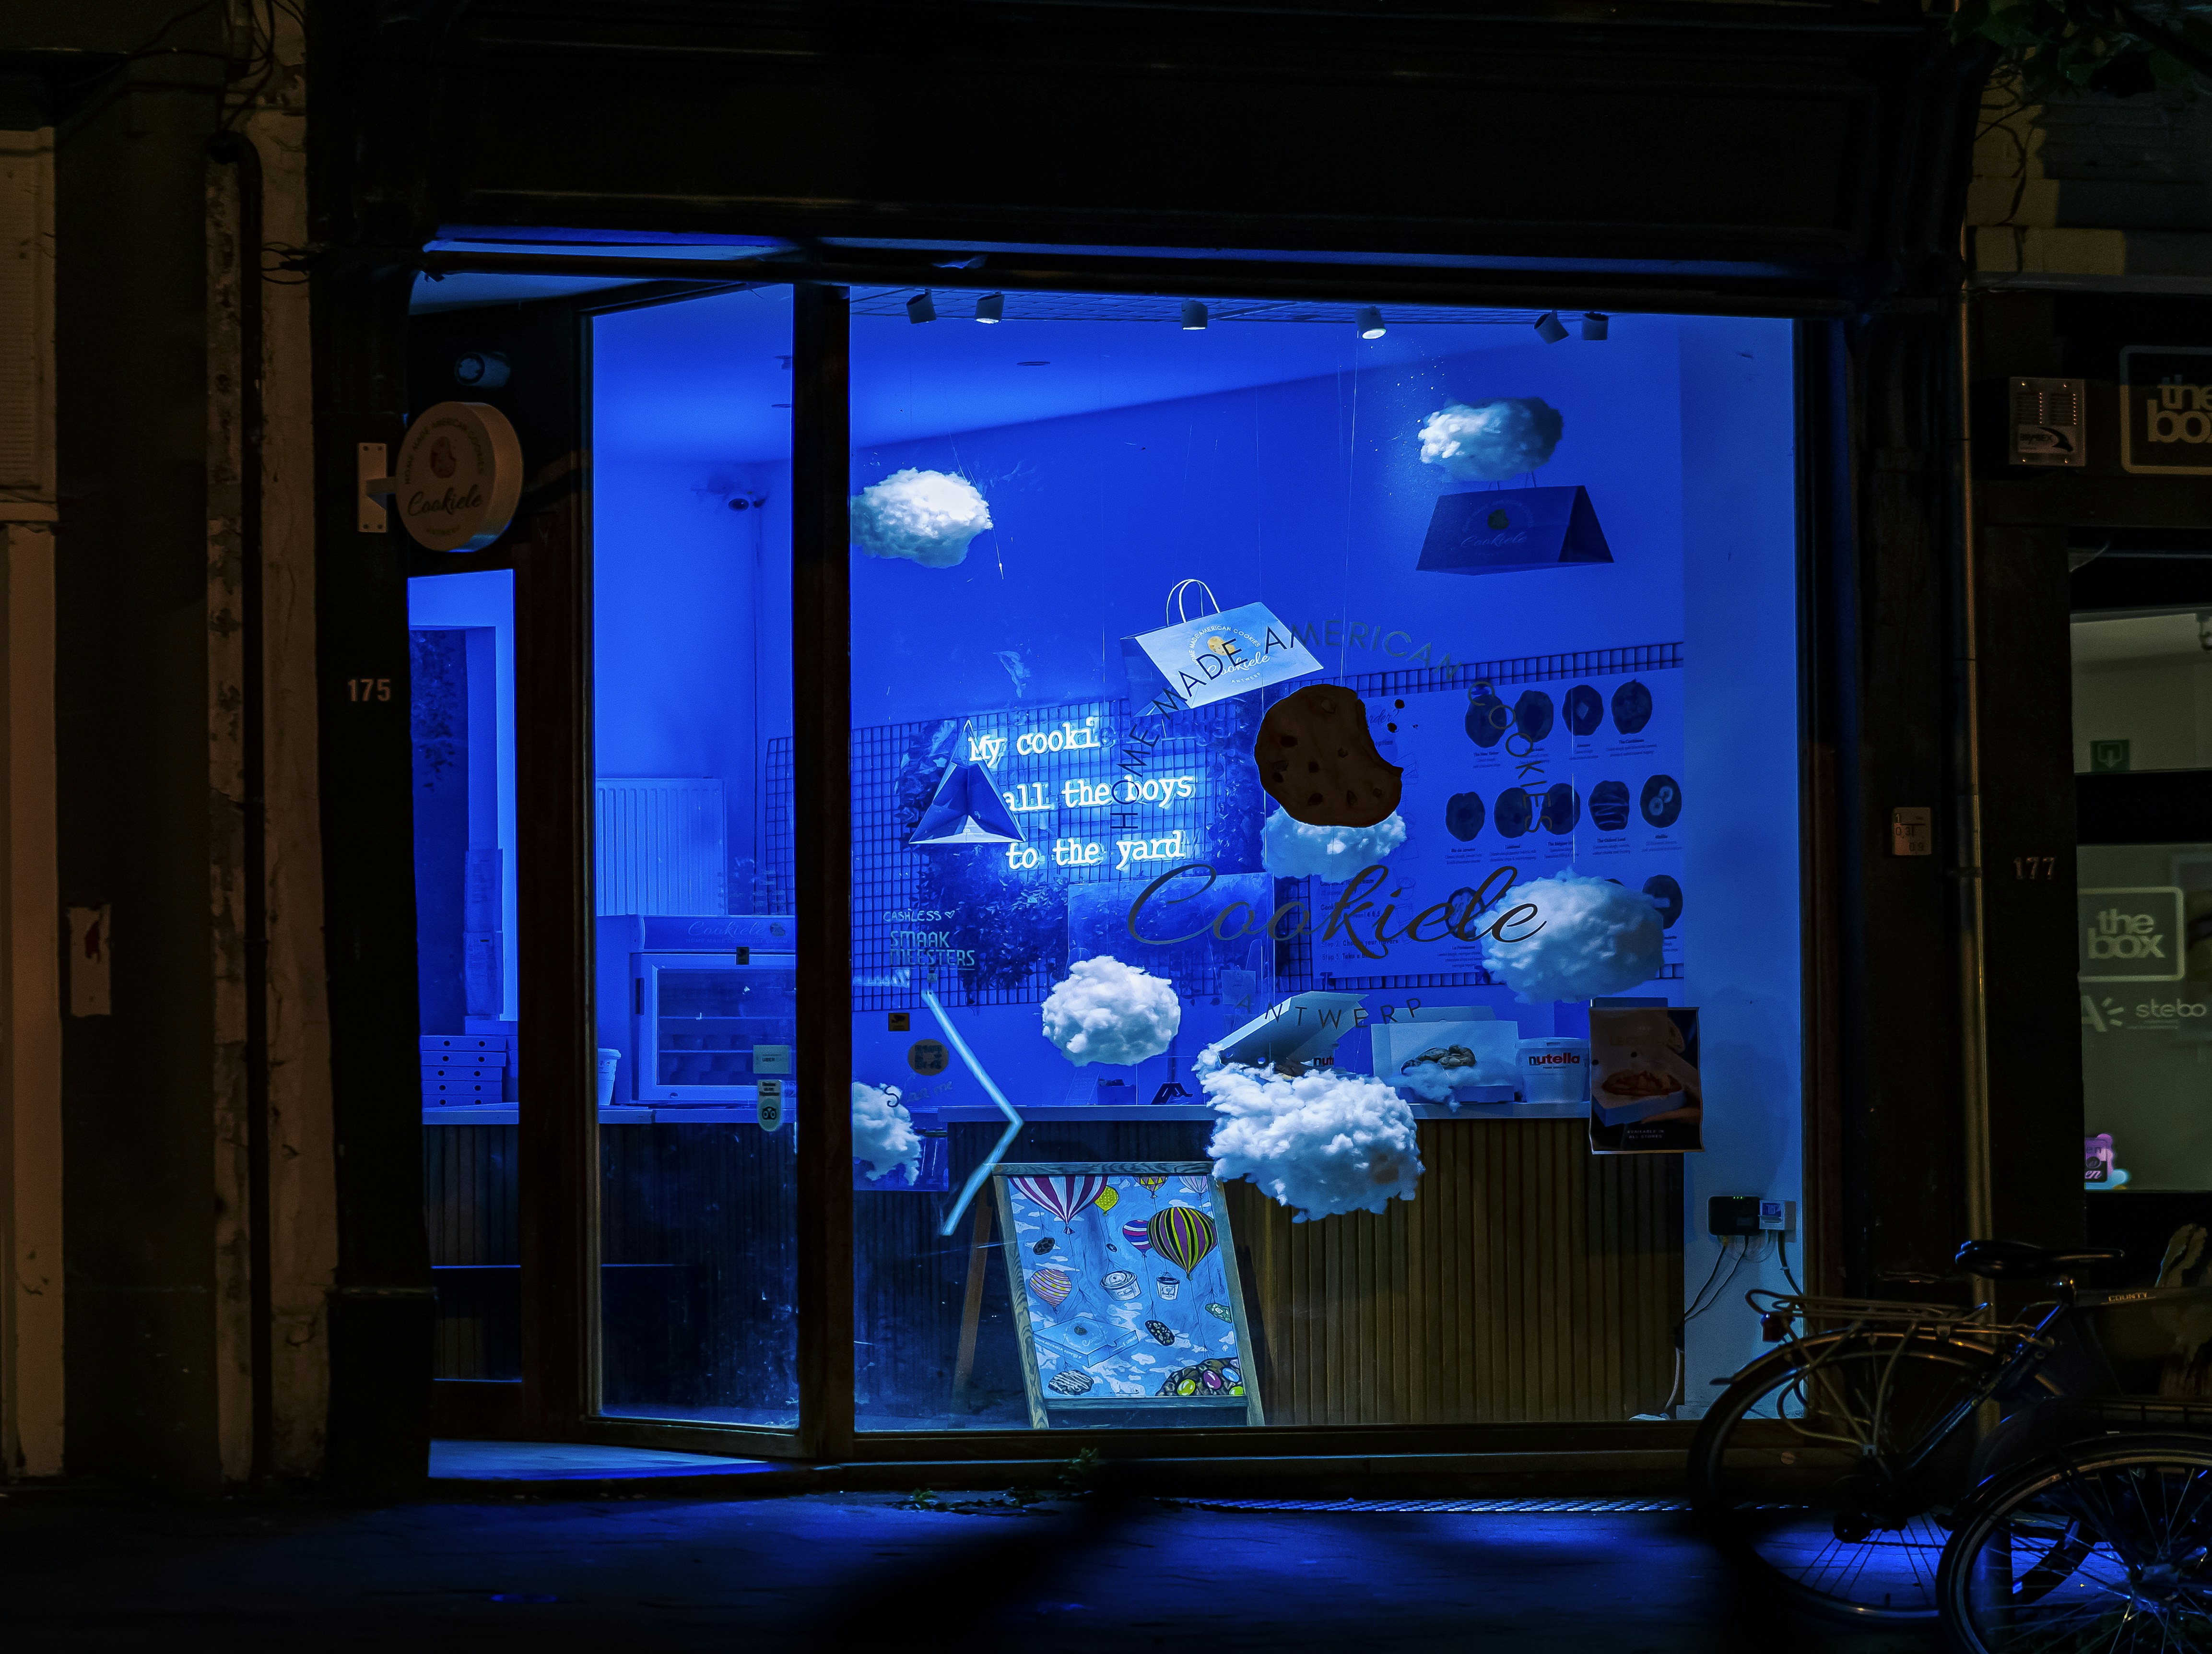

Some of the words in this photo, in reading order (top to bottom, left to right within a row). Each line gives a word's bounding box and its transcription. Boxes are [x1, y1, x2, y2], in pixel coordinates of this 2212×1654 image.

[412, 426, 430, 451] MADE
[431, 418, 468, 432] AMERICAN
[2147, 399, 2212, 444] bo
[408, 484, 482, 516] Cookiele
[1189, 634, 1200, 649] MADE
[1198, 625, 1232, 637] AMERICAN
[1233, 628, 1261, 648] COOKIES
[347, 678, 392, 702] 175
[1231, 672, 1261, 684] ANTWERP
[1110, 723, 1160, 829] HOME
[1151, 638, 1249, 721] MADE
[1265, 619, 1463, 680] AMERICAN
[1468, 681, 1553, 833] COOKIES
[967, 734, 1006, 768] My
[1002, 782, 1053, 812] all
[1060, 778, 1113, 809] the
[1123, 774, 1195, 809] boys
[1005, 841, 1039, 870] to
[1052, 837, 1104, 866] the
[1115, 828, 1187, 871] yard
[2013, 856, 2056, 880] 177
[882, 910, 942, 922] CASHLESS
[1127, 863, 1547, 959] Cookiele
[2096, 909, 2155, 935] the
[890, 930, 951, 948] SMAAK
[2088, 928, 2166, 958] box
[890, 948, 976, 967] MEESTERS
[1235, 994, 1422, 1030] ANTWERP
[2135, 998, 2206, 1018] stebo
[1528, 1052, 1580, 1066] nutella
